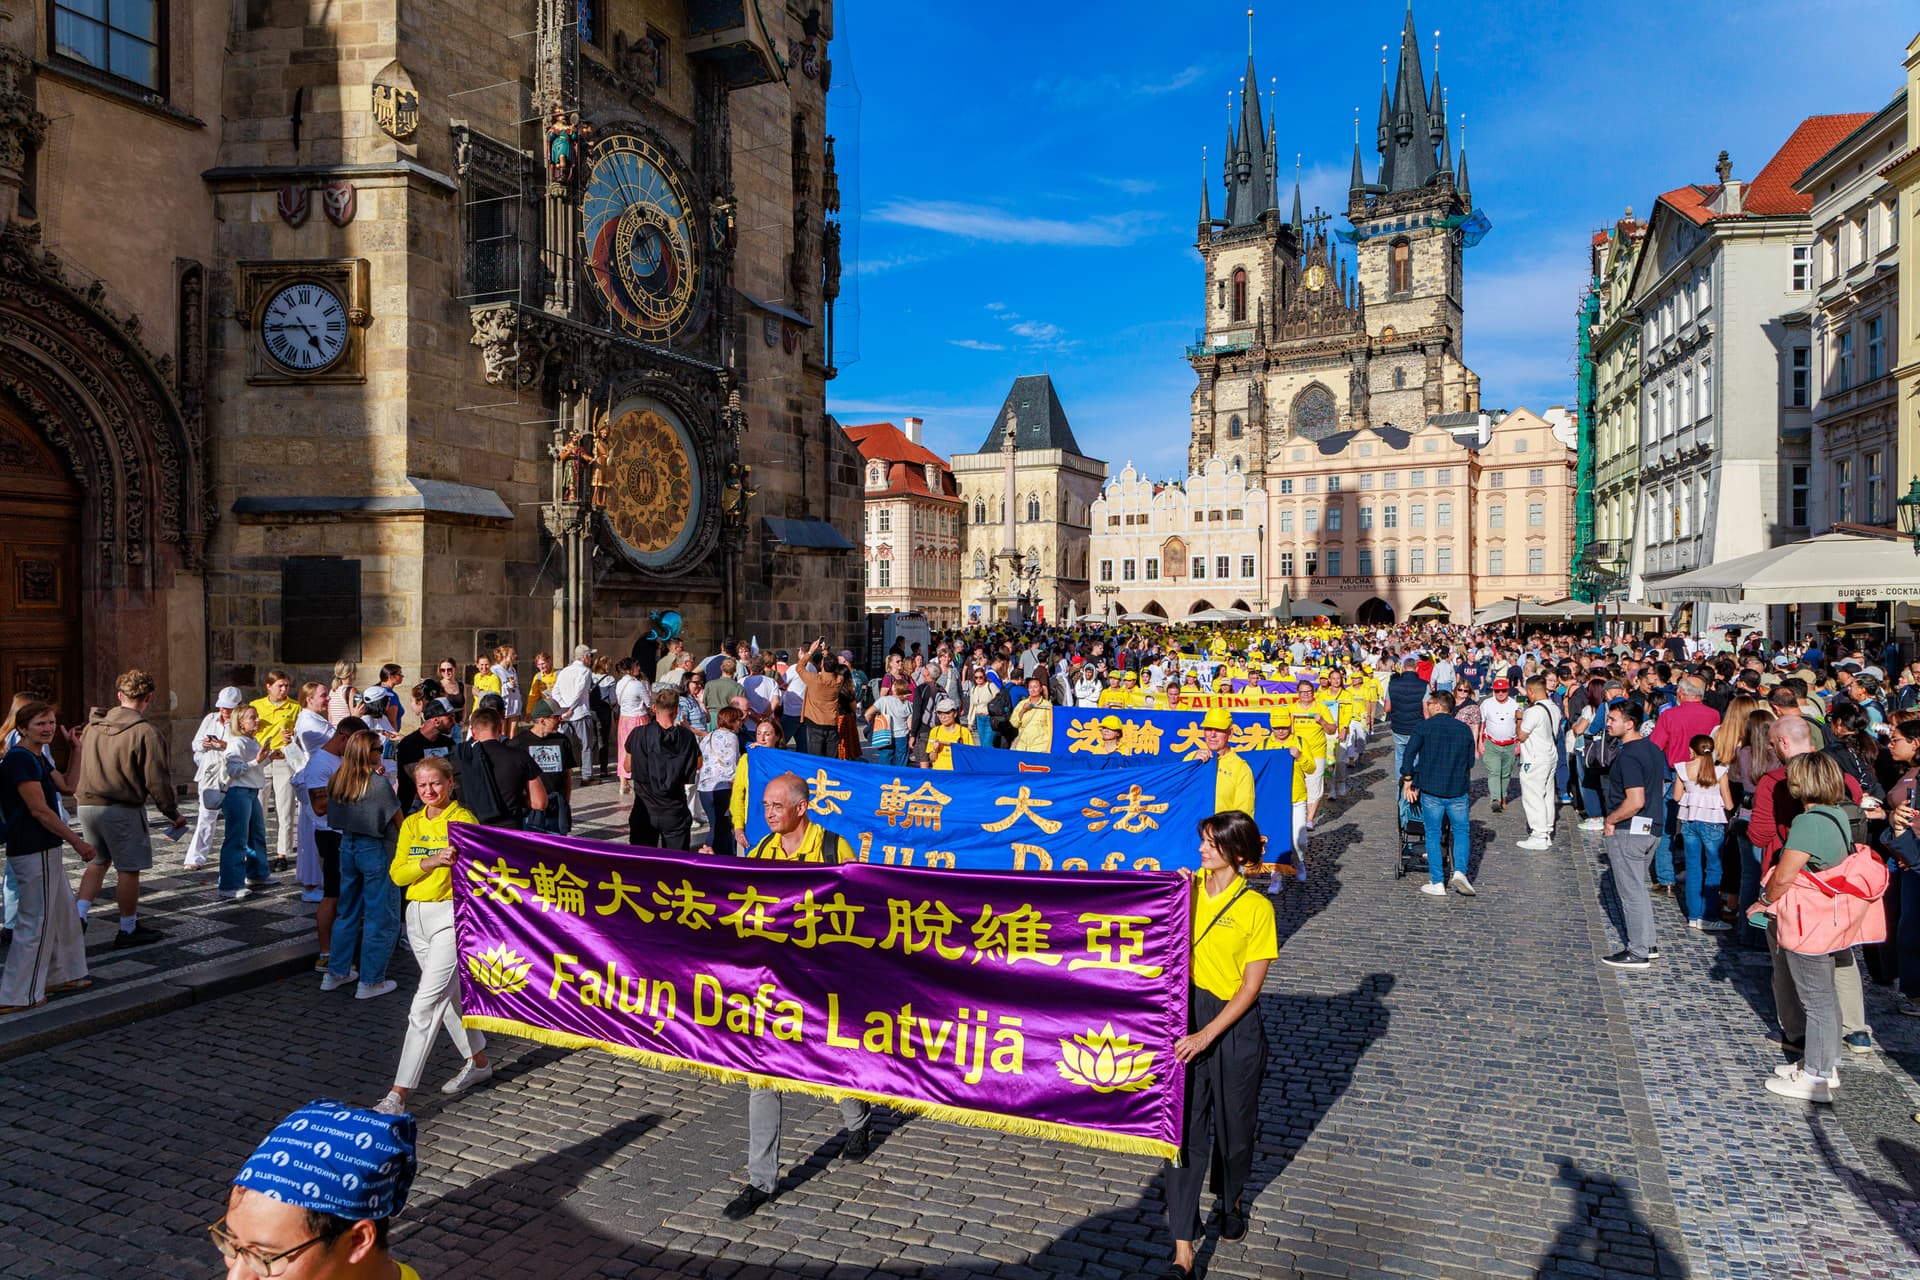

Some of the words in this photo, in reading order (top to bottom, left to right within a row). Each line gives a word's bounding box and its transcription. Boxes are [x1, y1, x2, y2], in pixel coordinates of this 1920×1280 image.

[298, 290, 310, 304] XII
[327, 322, 340, 331] III
[1838, 588, 1877, 597] BURGERS
[694, 973, 804, 1042] Dafa
[826, 993, 1024, 1084] Latvijā
